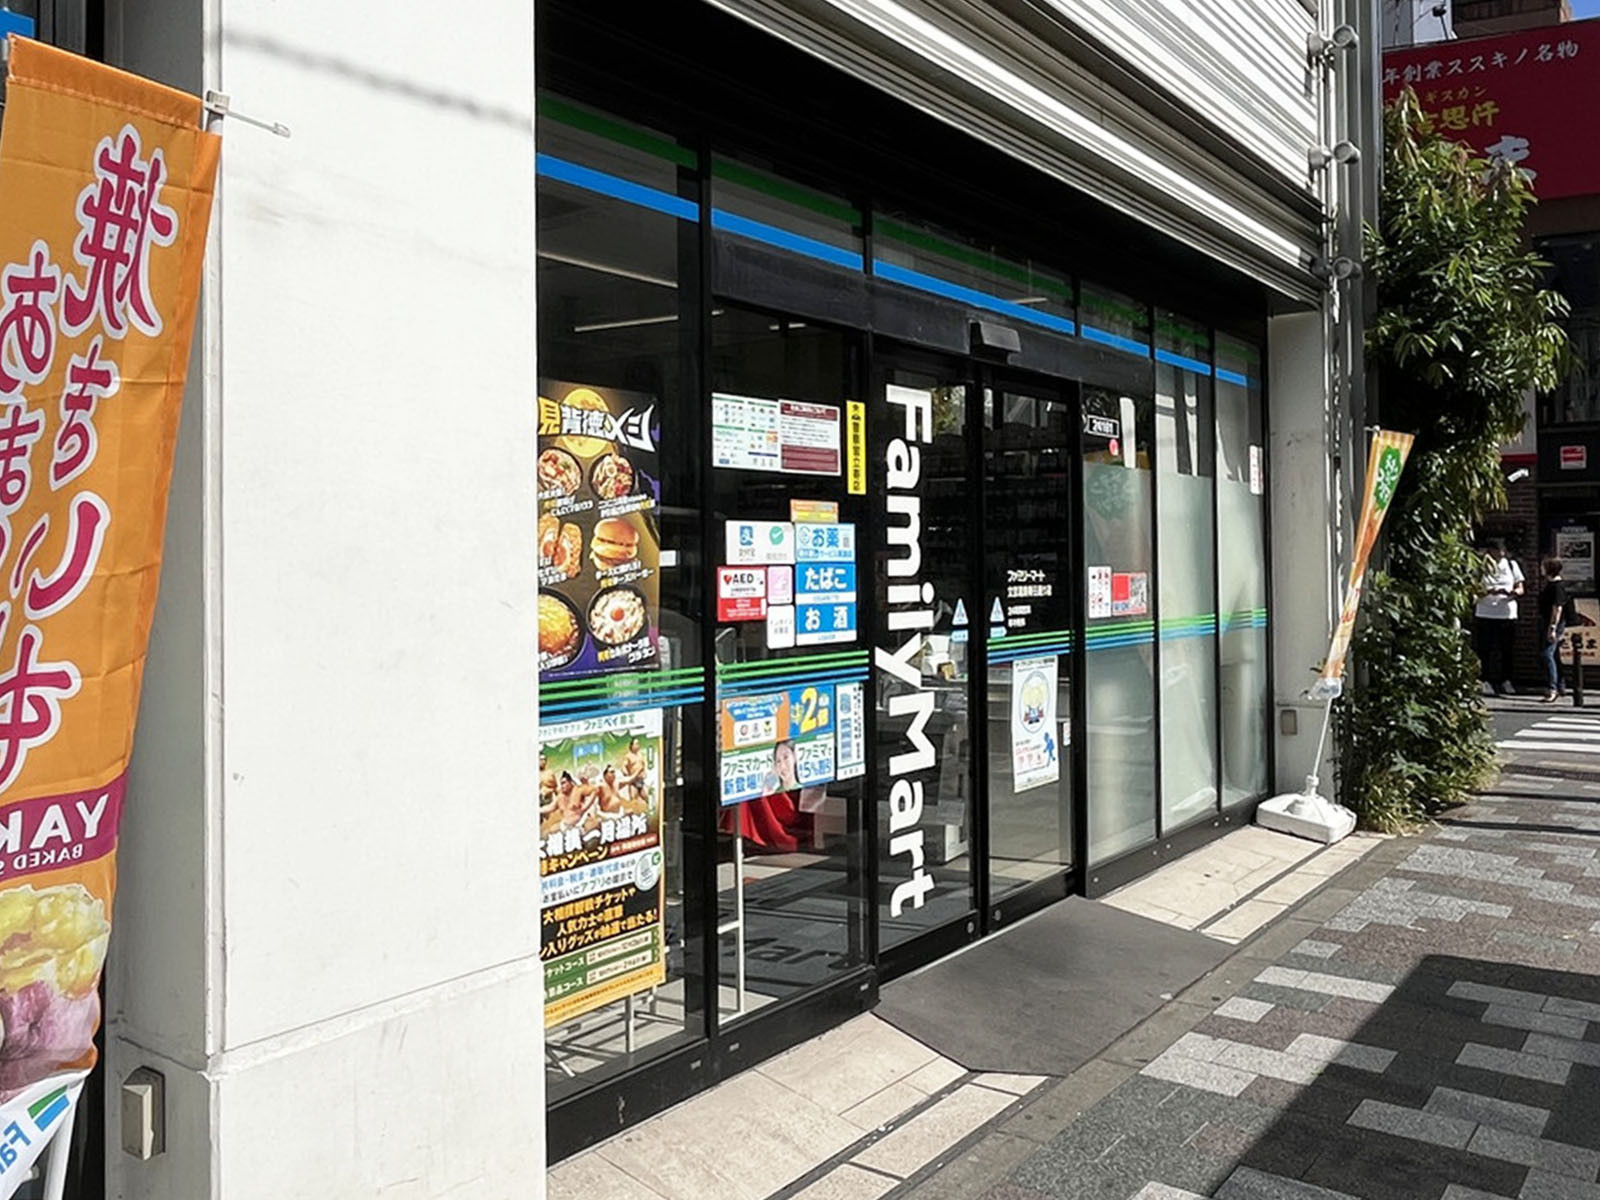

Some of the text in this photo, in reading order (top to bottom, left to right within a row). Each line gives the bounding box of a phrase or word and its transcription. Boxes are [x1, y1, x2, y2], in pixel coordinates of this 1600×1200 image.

[732, 573, 754, 584] AED
[805, 567, 848, 591] たばこ
[876, 384, 937, 917] FamilyMart
